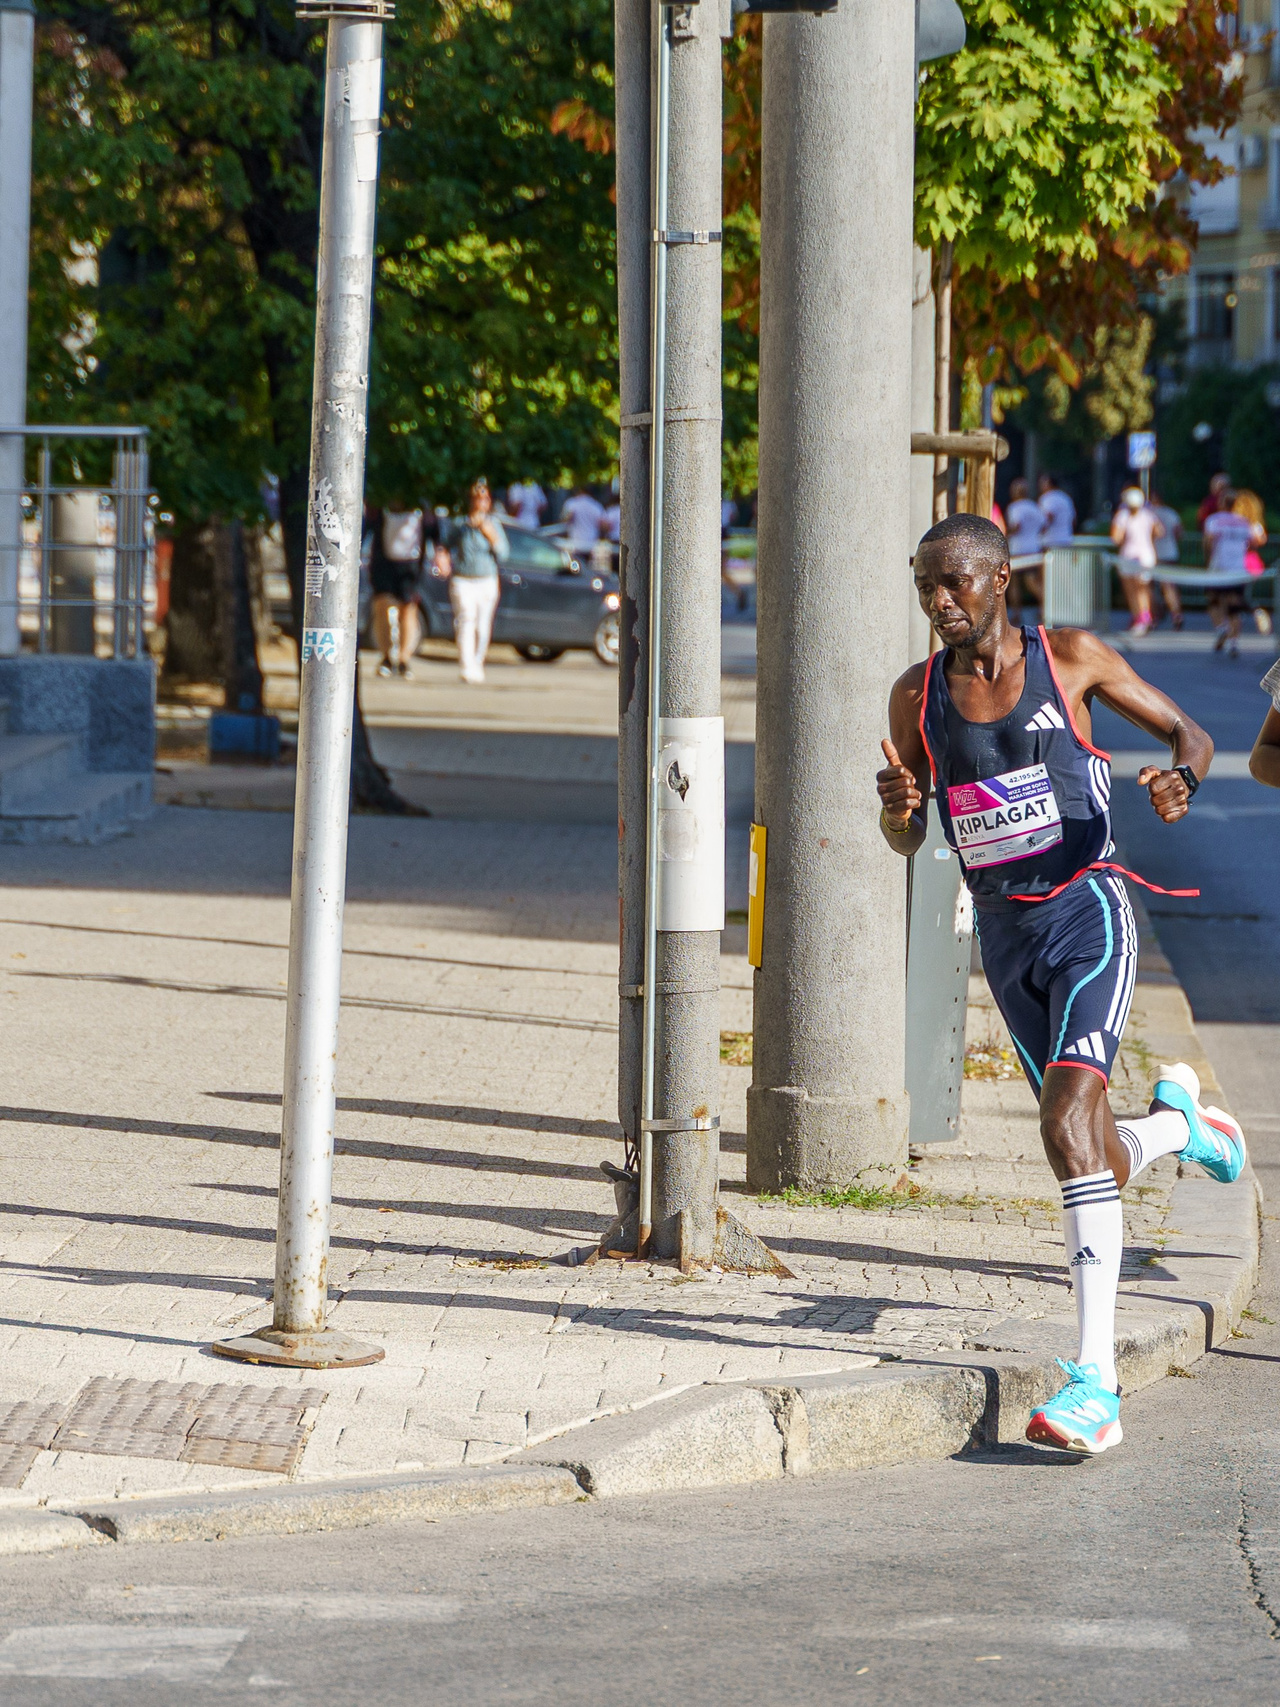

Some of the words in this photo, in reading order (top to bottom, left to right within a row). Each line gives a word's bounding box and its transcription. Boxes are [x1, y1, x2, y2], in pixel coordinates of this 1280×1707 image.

[1008, 772, 1031, 784] 42.195
[1031, 780, 1048, 790] SOFIA
[1008, 790, 1037, 800] MARATHON
[957, 798, 1048, 835] KIPLAGAT
[1070, 1257, 1102, 1267] adidas
